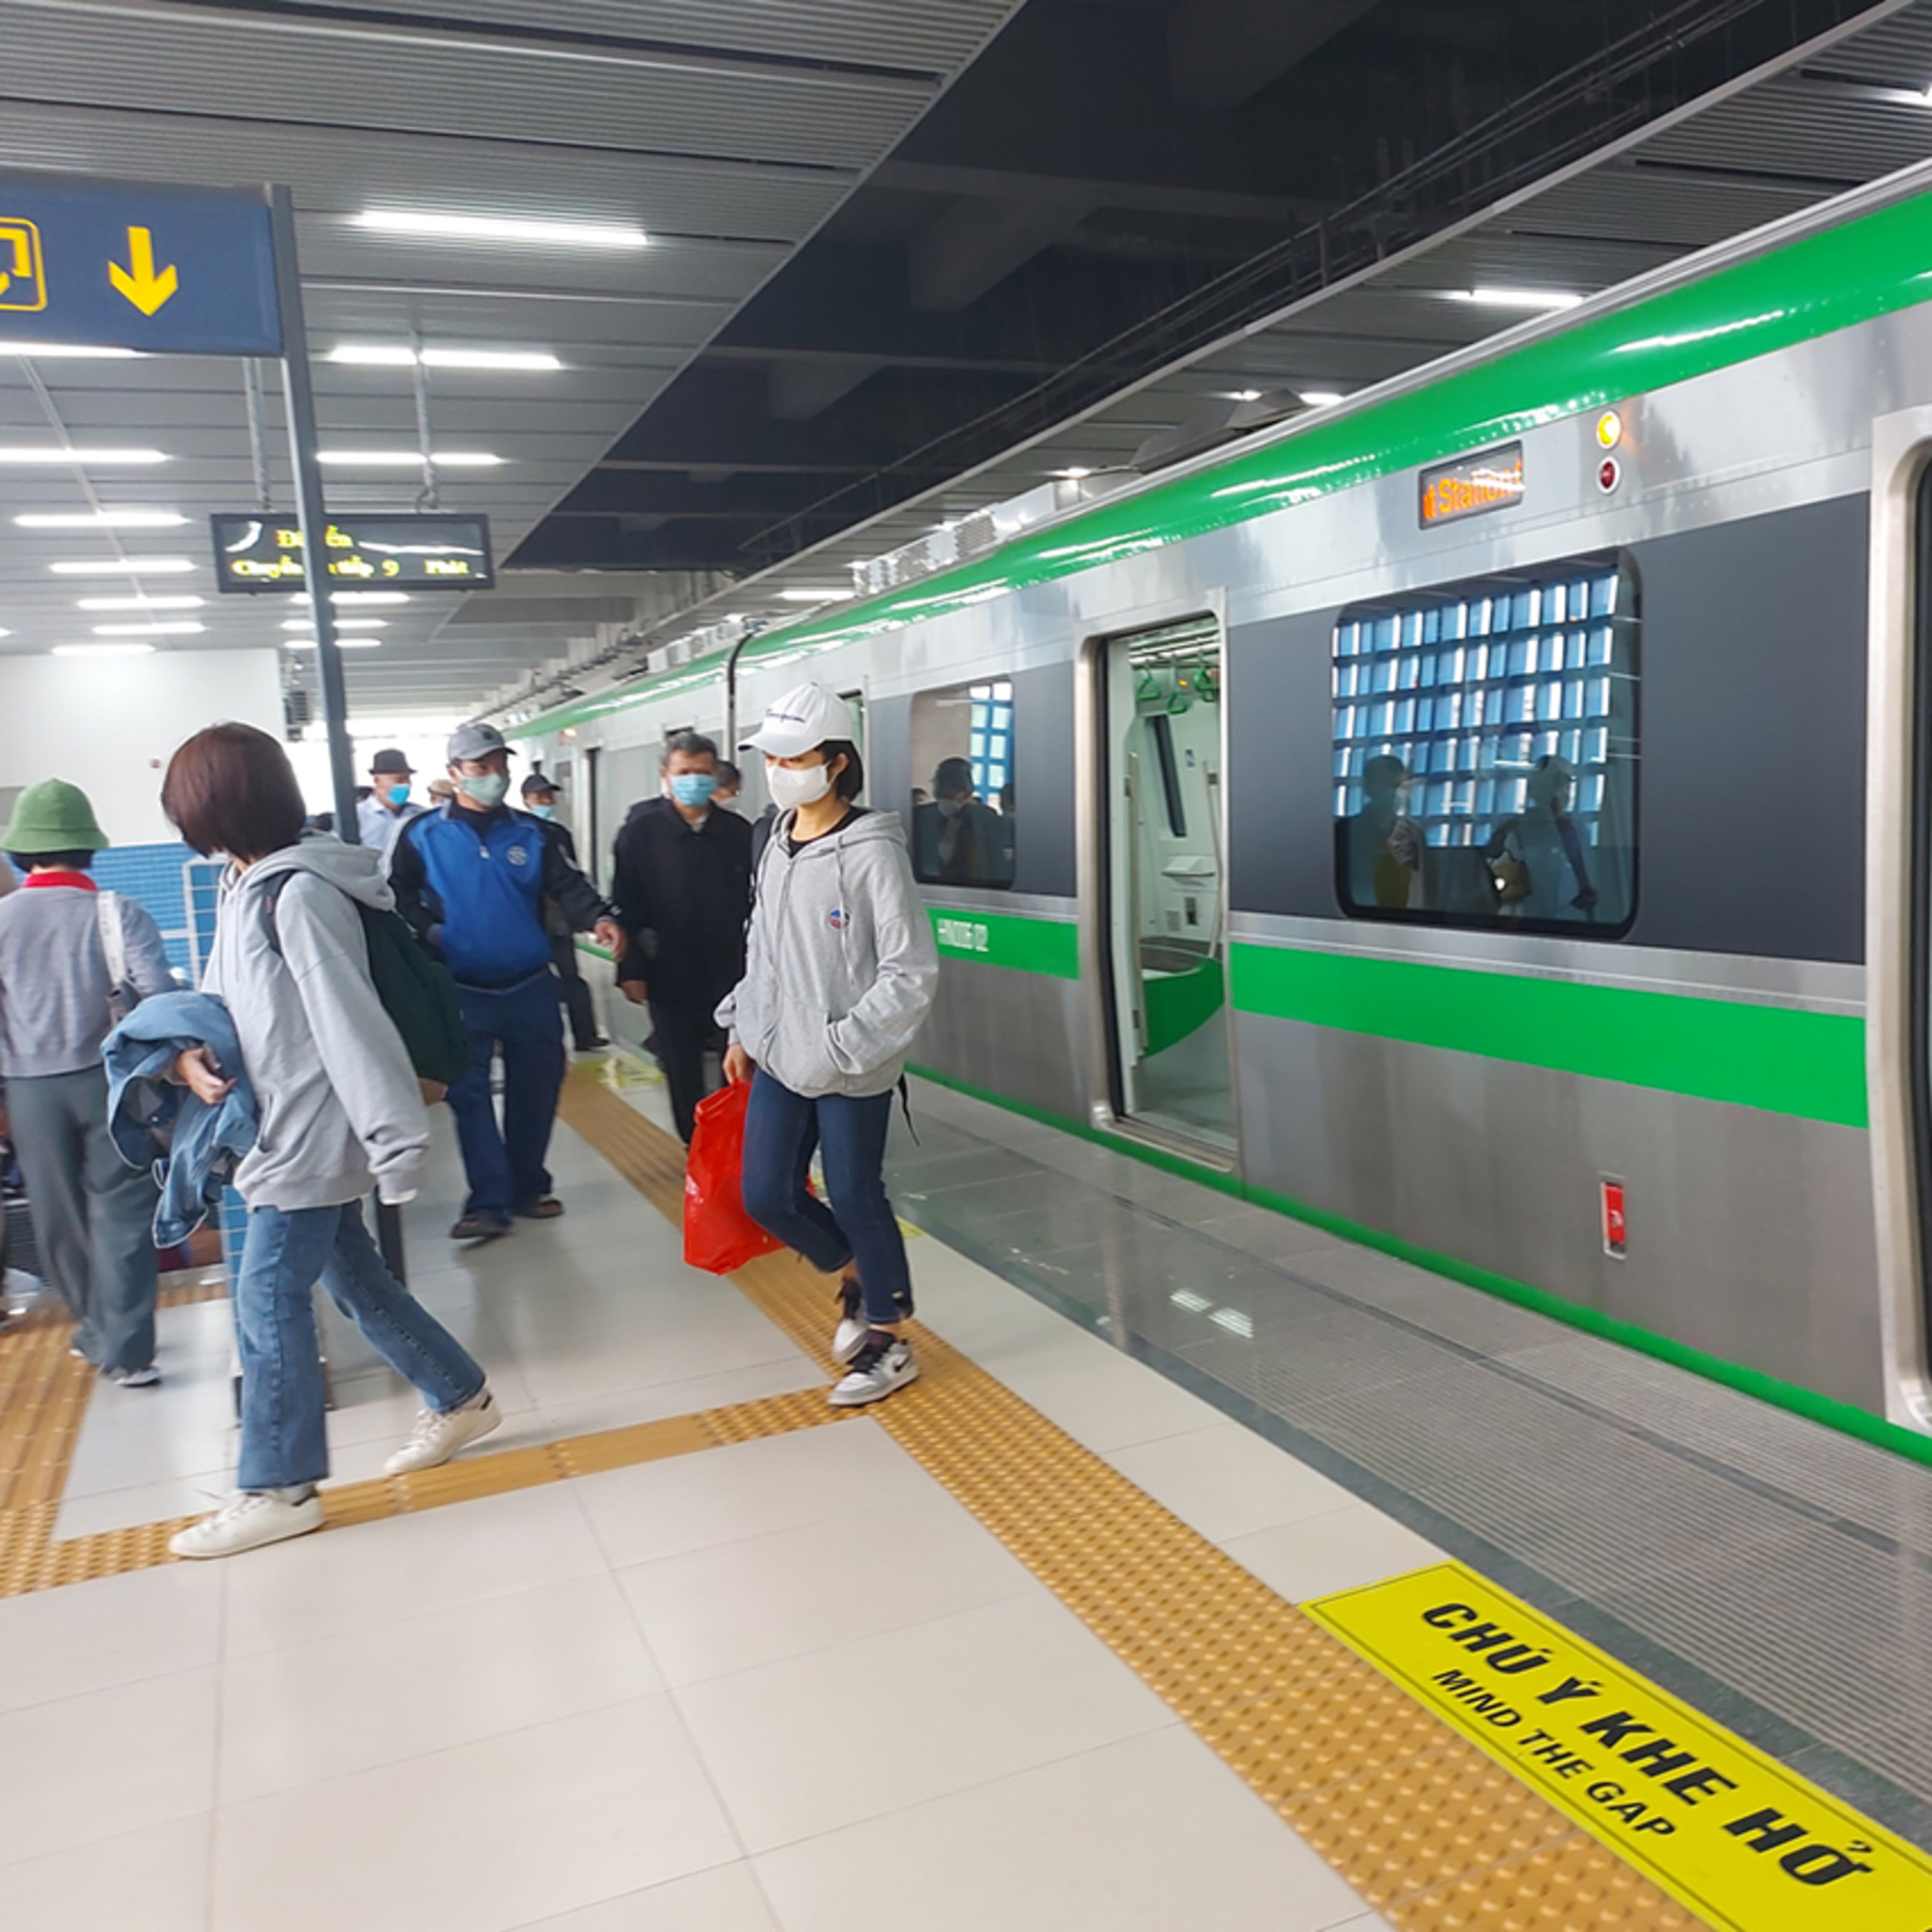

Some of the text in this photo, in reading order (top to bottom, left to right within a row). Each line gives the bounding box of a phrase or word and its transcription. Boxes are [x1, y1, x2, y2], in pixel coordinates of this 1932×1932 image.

[381, 558, 400, 577] 9
[1422, 1602, 1873, 1886] CHÚ Ý KHE HỞ
[1432, 1669, 1676, 1838] MIND THE GAP
